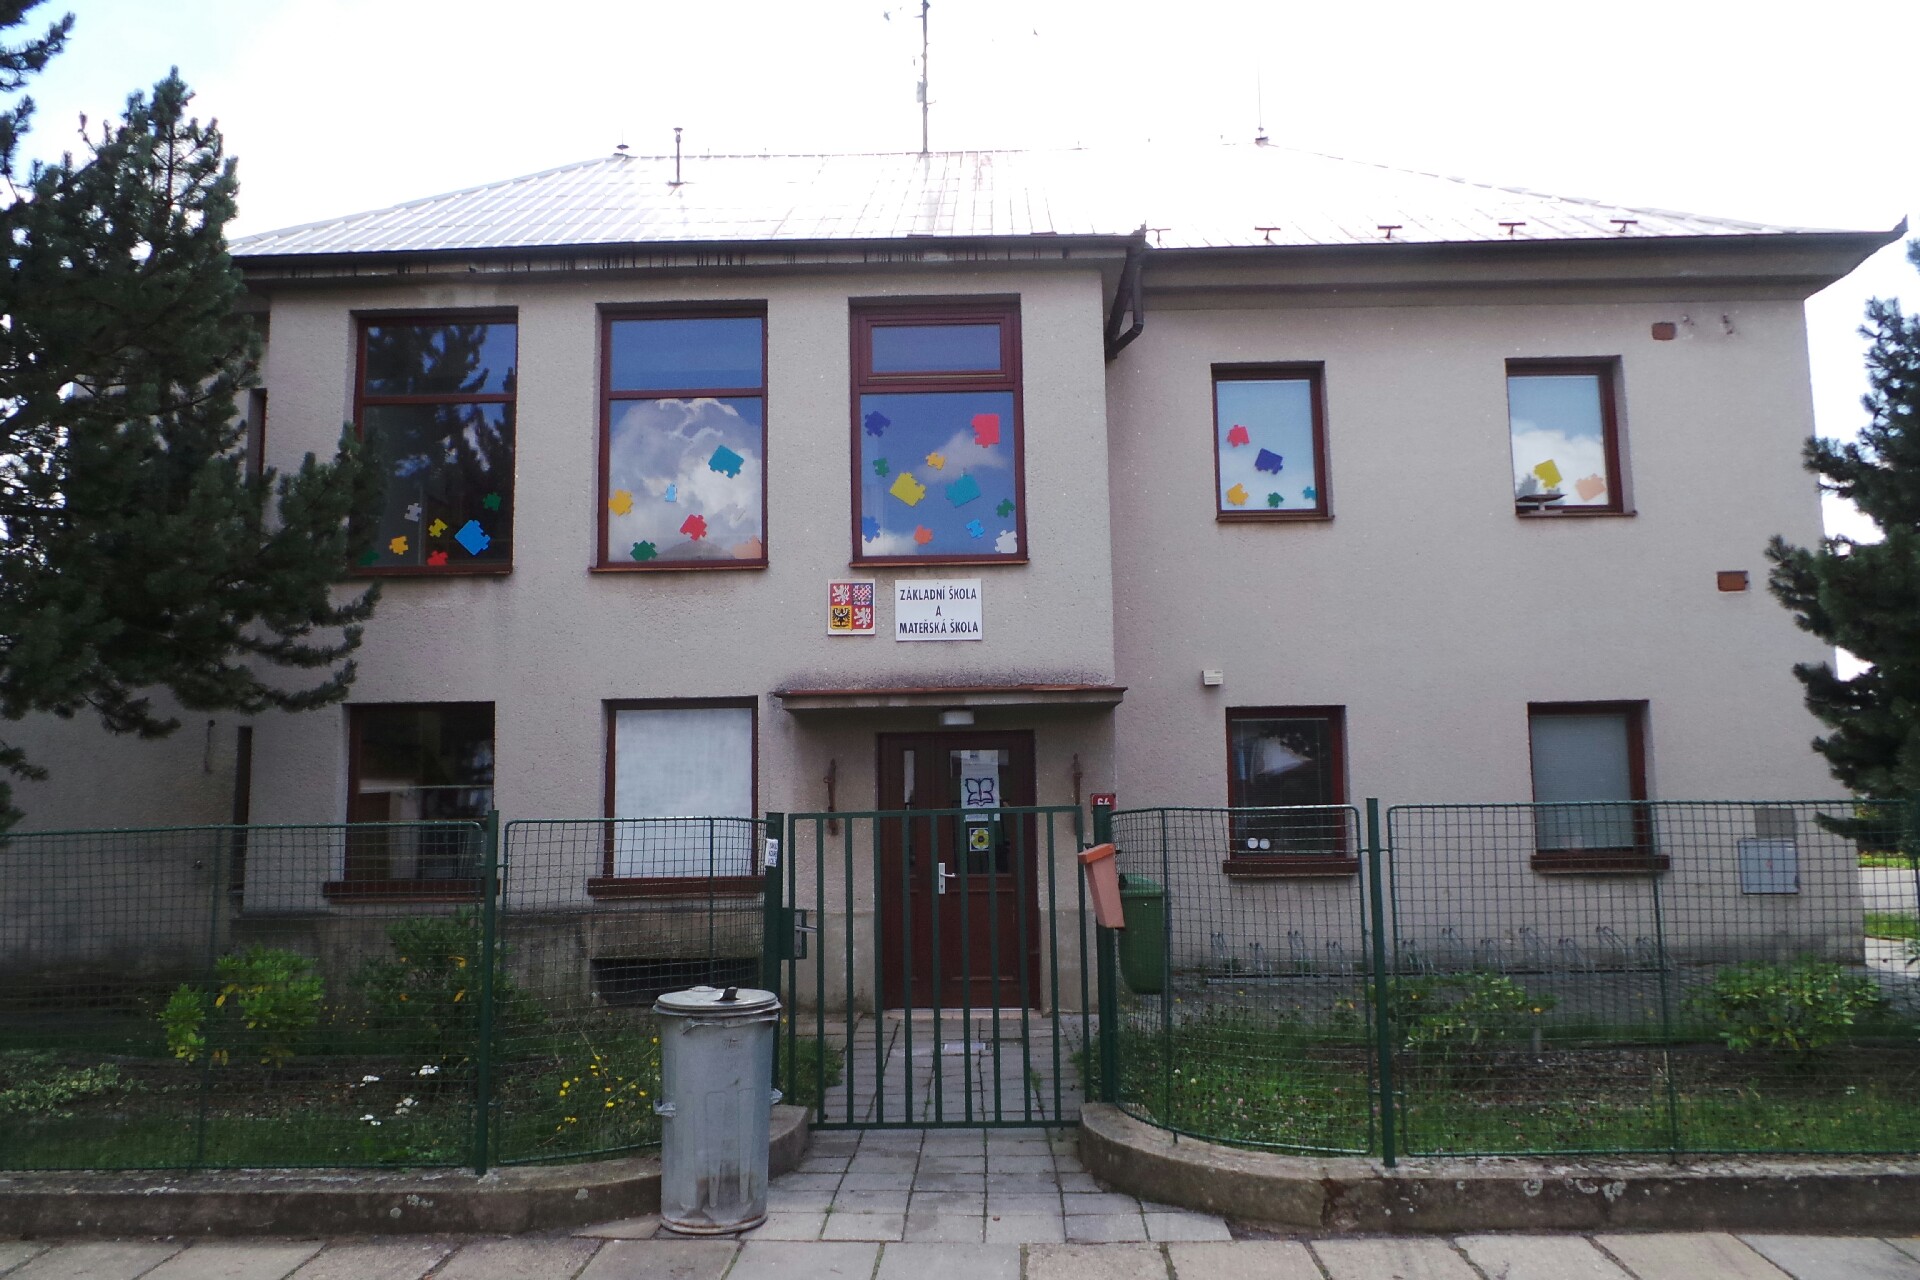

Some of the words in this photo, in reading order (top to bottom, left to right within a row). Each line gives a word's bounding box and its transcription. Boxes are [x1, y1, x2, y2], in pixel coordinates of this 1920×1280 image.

[900, 586, 945, 600] ZÁKLADNÍ
[949, 586, 977, 600] ŠKOLA
[936, 605, 942, 616] A
[899, 619, 947, 633] MATEŘSKÁ
[950, 619, 979, 633] ŠKOLA
